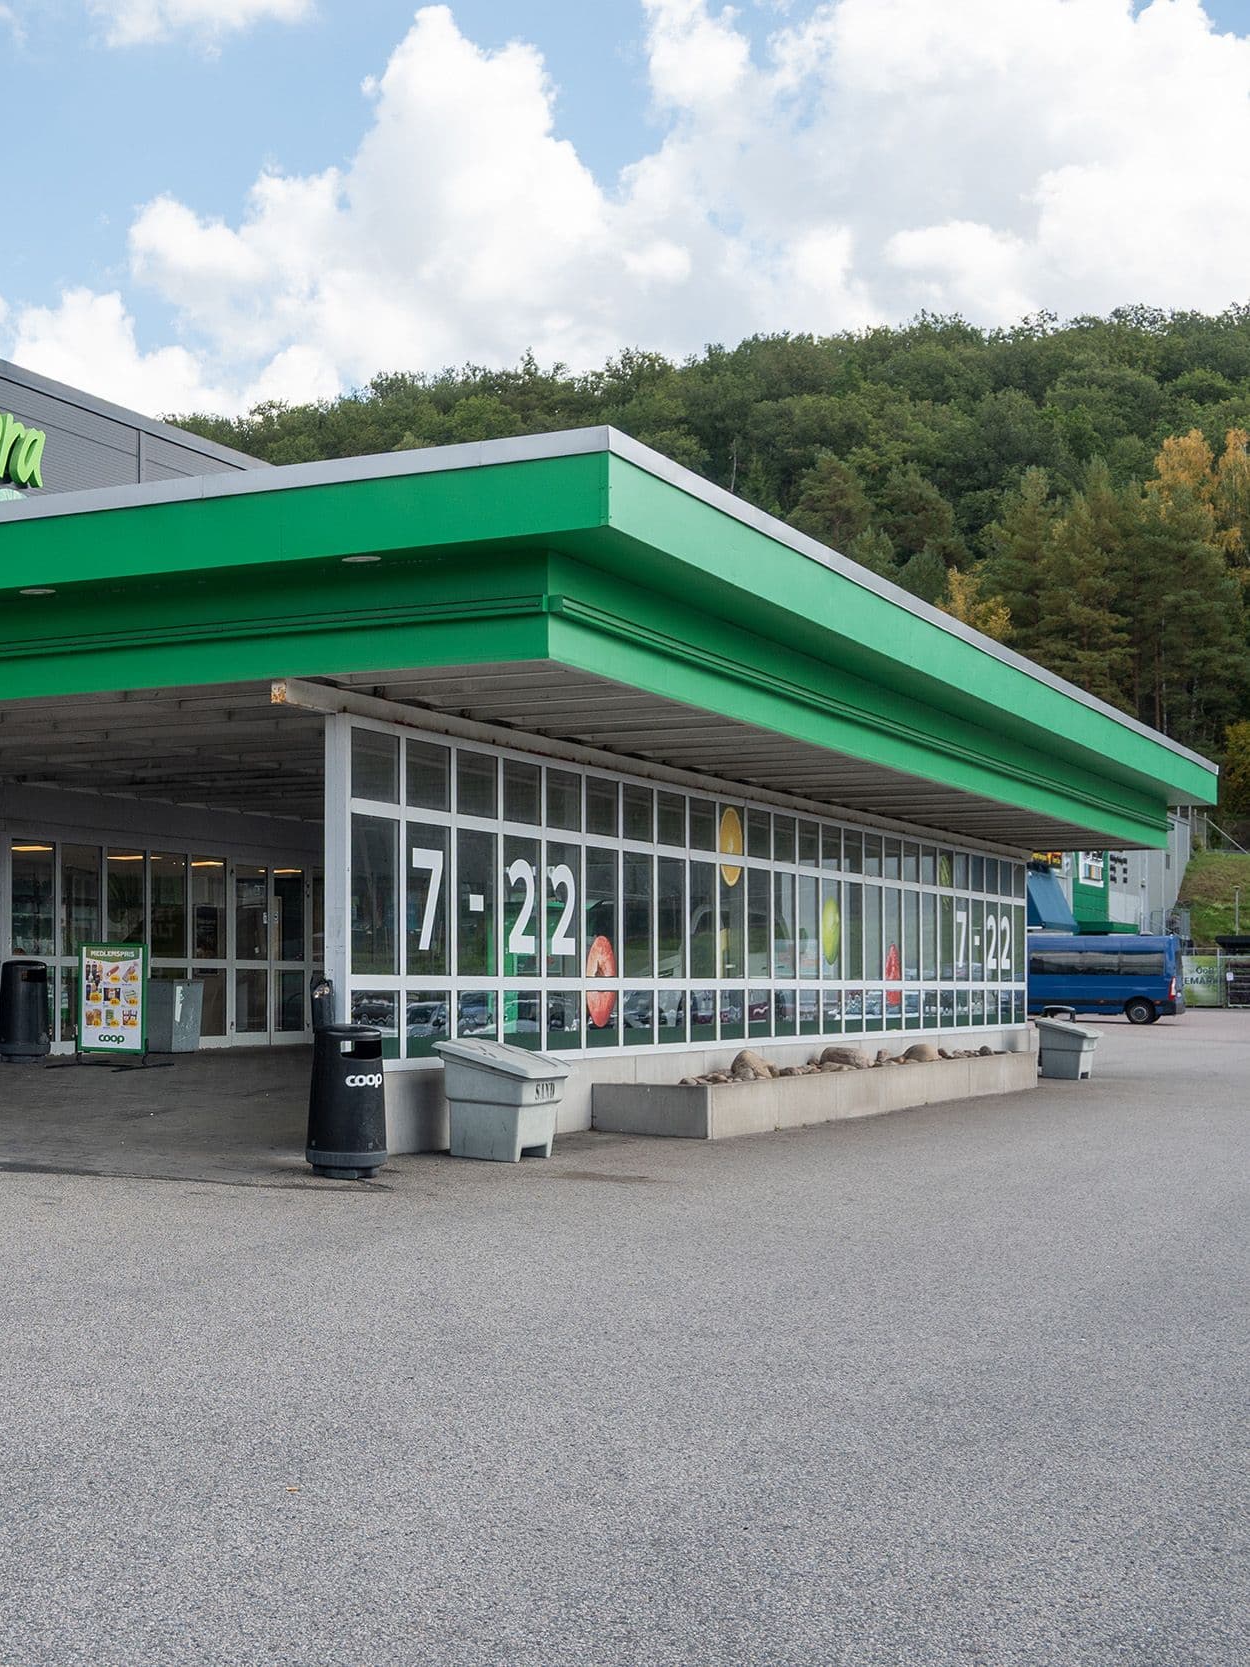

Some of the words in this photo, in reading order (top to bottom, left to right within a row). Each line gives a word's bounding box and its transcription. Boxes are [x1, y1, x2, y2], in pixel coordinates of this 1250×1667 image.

[90, 950, 135, 958] MEDLEMSPRIS
[98, 1034, 125, 1044] coop
[345, 1073, 383, 1088] coop
[535, 1082, 556, 1100] SAND
